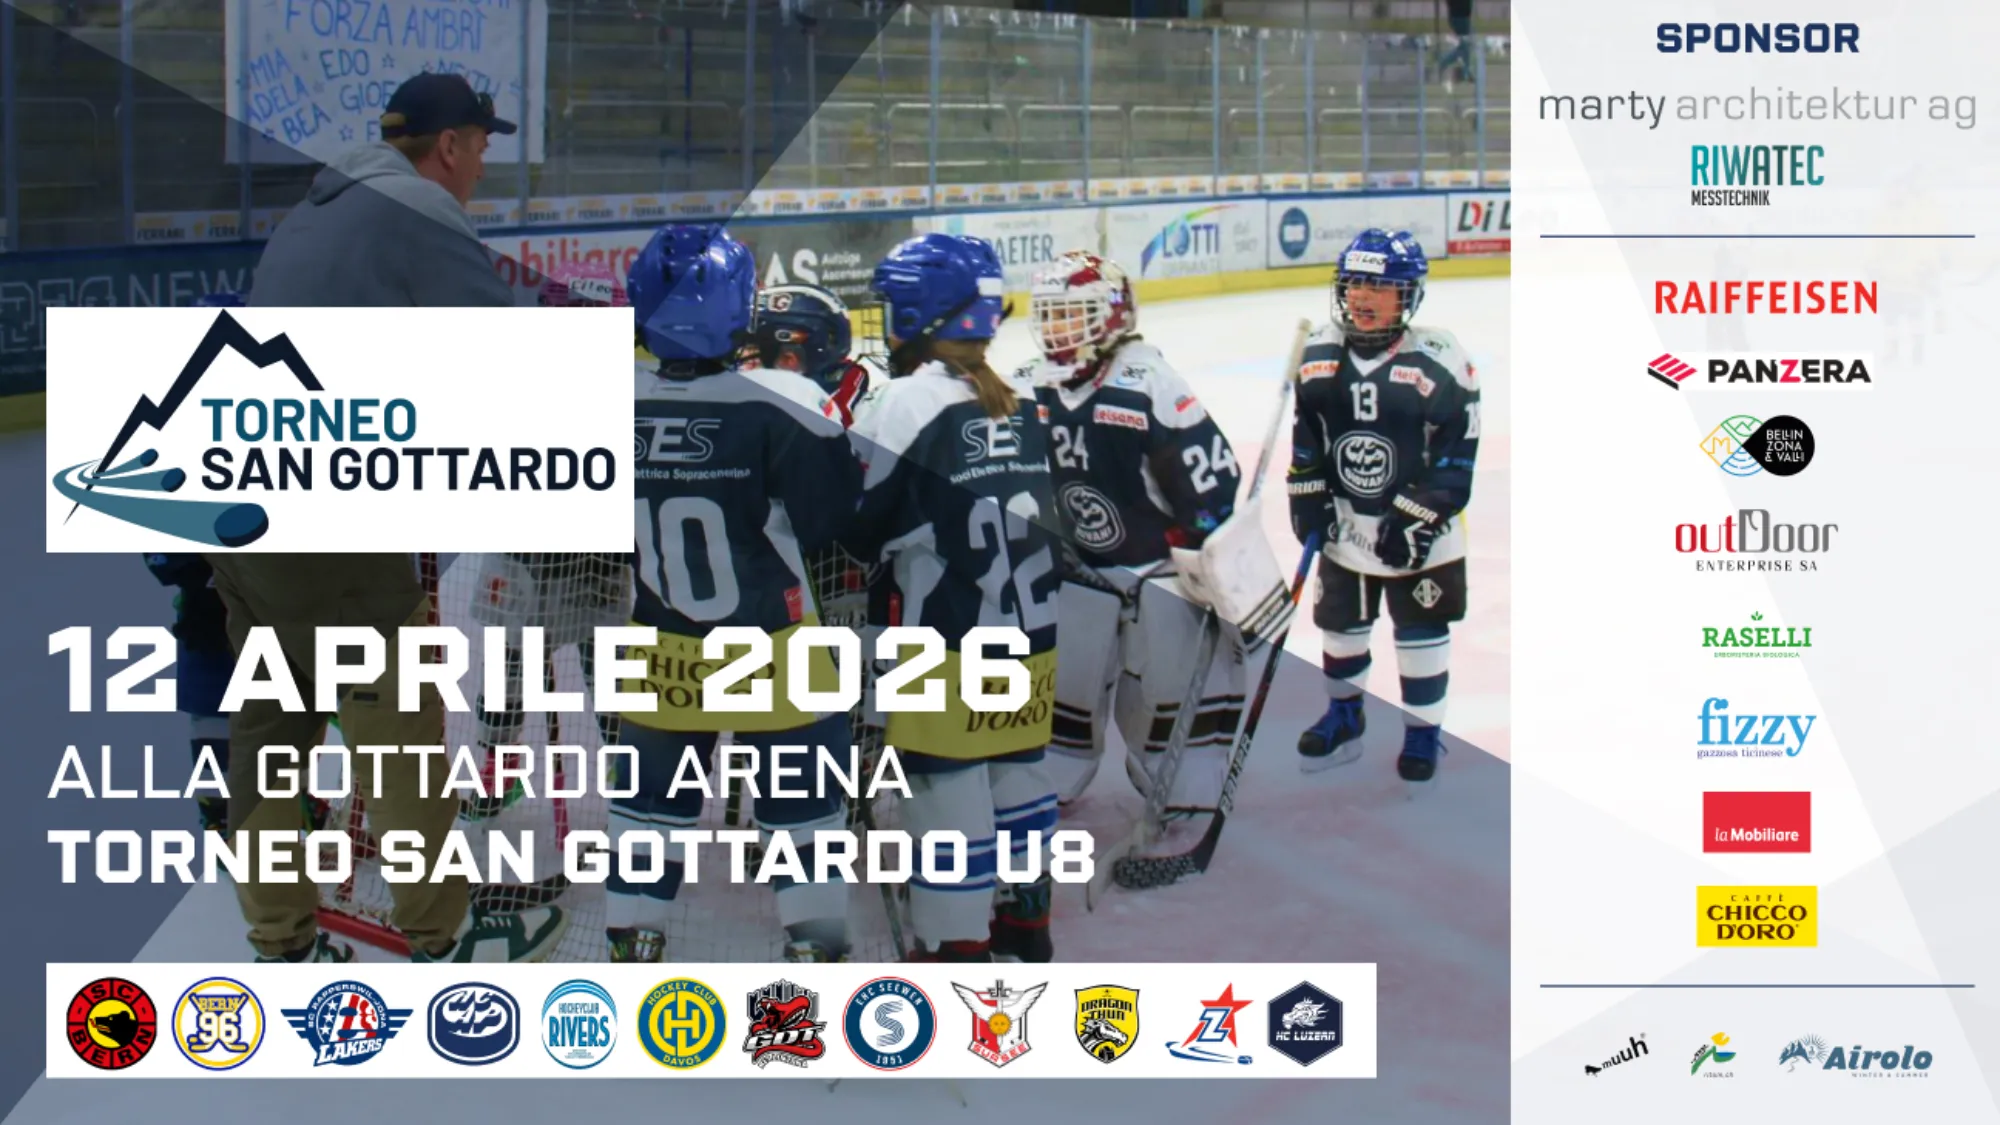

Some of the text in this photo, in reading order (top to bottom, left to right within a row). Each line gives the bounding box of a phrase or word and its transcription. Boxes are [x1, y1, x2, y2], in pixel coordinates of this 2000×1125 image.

[286, 0, 394, 45] FORZA
[250, 49, 291, 88] MIA
[318, 48, 370, 81] EDO
[281, 103, 332, 145] BEA
[1162, 223, 1219, 258] LOTTI
[1350, 382, 1379, 422] 13
[1052, 425, 1089, 471] 24
[1183, 435, 1239, 494] 24
